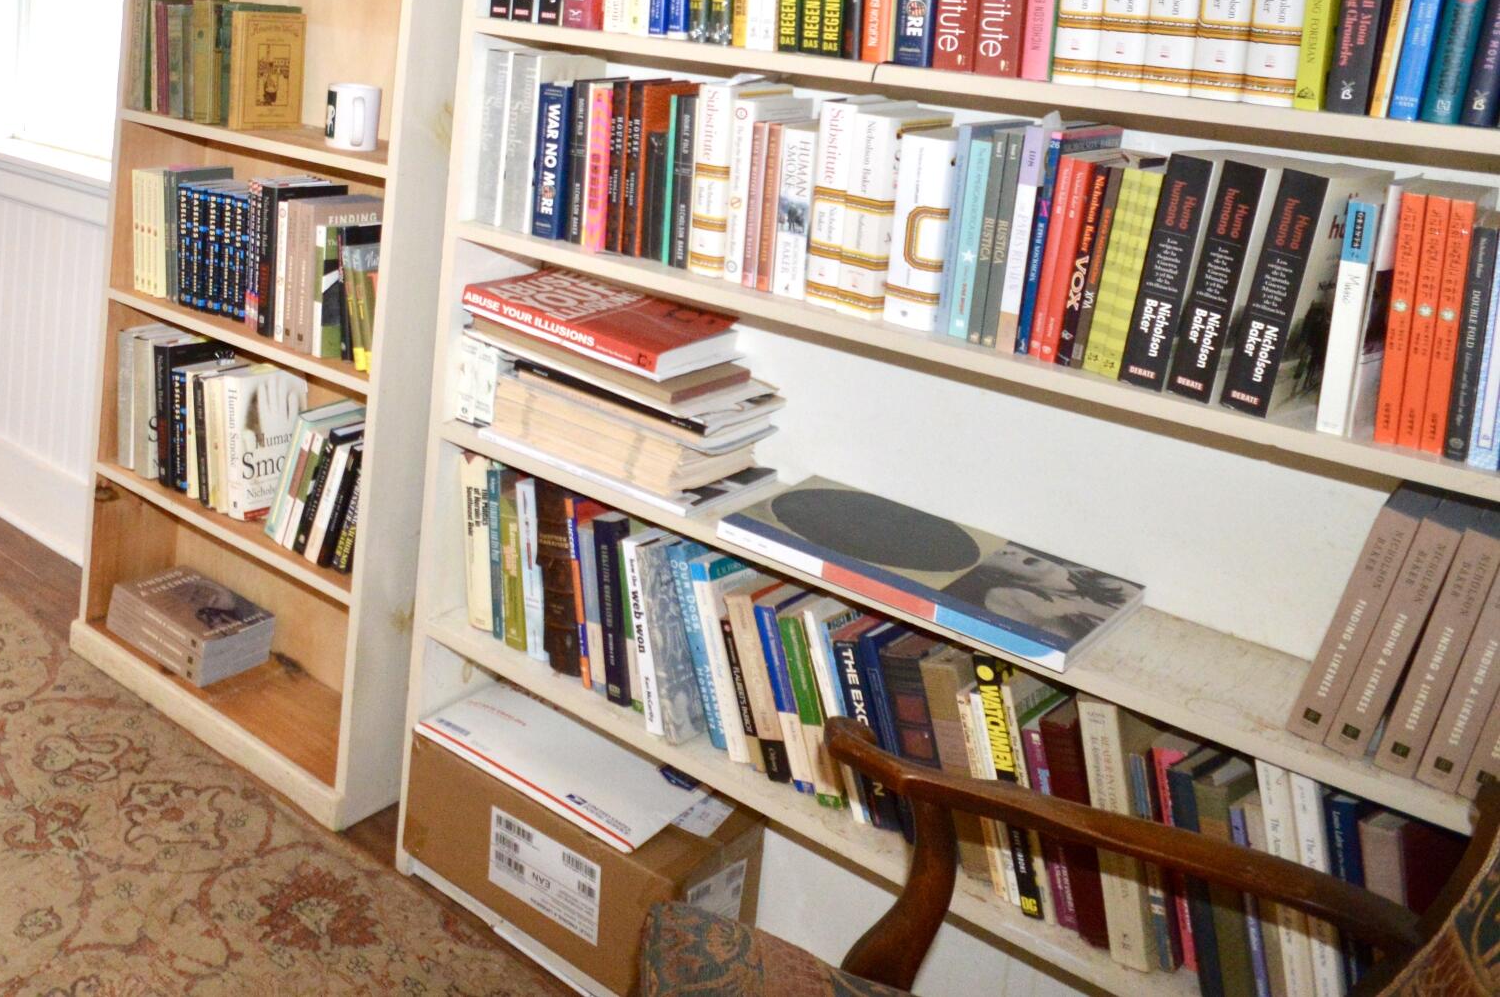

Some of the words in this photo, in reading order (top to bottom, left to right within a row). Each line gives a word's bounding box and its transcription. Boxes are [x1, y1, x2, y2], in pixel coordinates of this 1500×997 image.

[780, 37, 795, 45] DAS
[803, 40, 819, 48] DAS
[822, 42, 838, 51] DAS
[1031, 6, 1045, 51] NICHOLSON
[1306, 18, 1319, 63] FOREMAN
[1338, 9, 1357, 66] Chronicles
[546, 104, 561, 139] WAR
[703, 90, 720, 161] Substitute
[863, 120, 877, 165] Nicholson
[544, 142, 558, 169] NO
[784, 145, 797, 190] SMOKE
[824, 108, 845, 184] Substitute
[795, 141, 811, 197] HUMAN
[860, 168, 871, 194] Baker
[540, 171, 557, 215] MORE
[1087, 175, 1106, 223] Nicholson
[329, 213, 377, 225] FINDING
[980, 217, 995, 261] RUSTICA
[1080, 225, 1095, 252] Baker
[780, 241, 791, 274] BAKER
[994, 220, 1008, 264] RUSTICA
[1066, 255, 1090, 311] VOX
[464, 291, 500, 311] ABUSE
[502, 304, 533, 324] YOUR
[534, 317, 595, 347] ILLUSIONS
[1140, 298, 1159, 333] Baker
[1188, 308, 1208, 343] Baker
[1468, 290, 1481, 323] DOUBLE
[1148, 302, 1172, 358] Nicholson
[1196, 312, 1222, 369] Nicholson
[1244, 320, 1264, 358] Baker
[1466, 326, 1476, 348] FOLD
[1129, 365, 1156, 379] DEBATE
[1252, 325, 1279, 383] Nicholson
[1176, 376, 1203, 391] DEBATE
[1231, 390, 1260, 405] DEBATE
[228, 388, 238, 429] Human
[228, 433, 238, 468] Smoke
[242, 451, 286, 480] Smo
[1364, 537, 1386, 572] BAKER
[1372, 530, 1404, 589] NICHOLSON
[1404, 549, 1426, 588] BAKER
[1414, 542, 1447, 604] NICHOLSON
[1450, 561, 1471, 598] BAKER
[1459, 554, 1491, 616] NICHOLSON
[630, 590, 644, 620] web
[1342, 599, 1366, 641] FINDING
[635, 625, 647, 653] won
[1381, 613, 1407, 656] FINDING
[1429, 626, 1454, 671] FINDING
[841, 648, 860, 686] THE
[1317, 653, 1343, 698] LIKENESS
[1472, 640, 1499, 684] FINDING
[696, 667, 716, 730] HOROWITZ
[704, 664, 725, 735] ALEXANDRA
[850, 689, 869, 727] EXC
[1355, 668, 1382, 714] LIKENESS
[1405, 683, 1431, 731] LIKENESS
[980, 685, 1014, 772] WATCHMEN
[1448, 697, 1475, 747] LIKENESS
